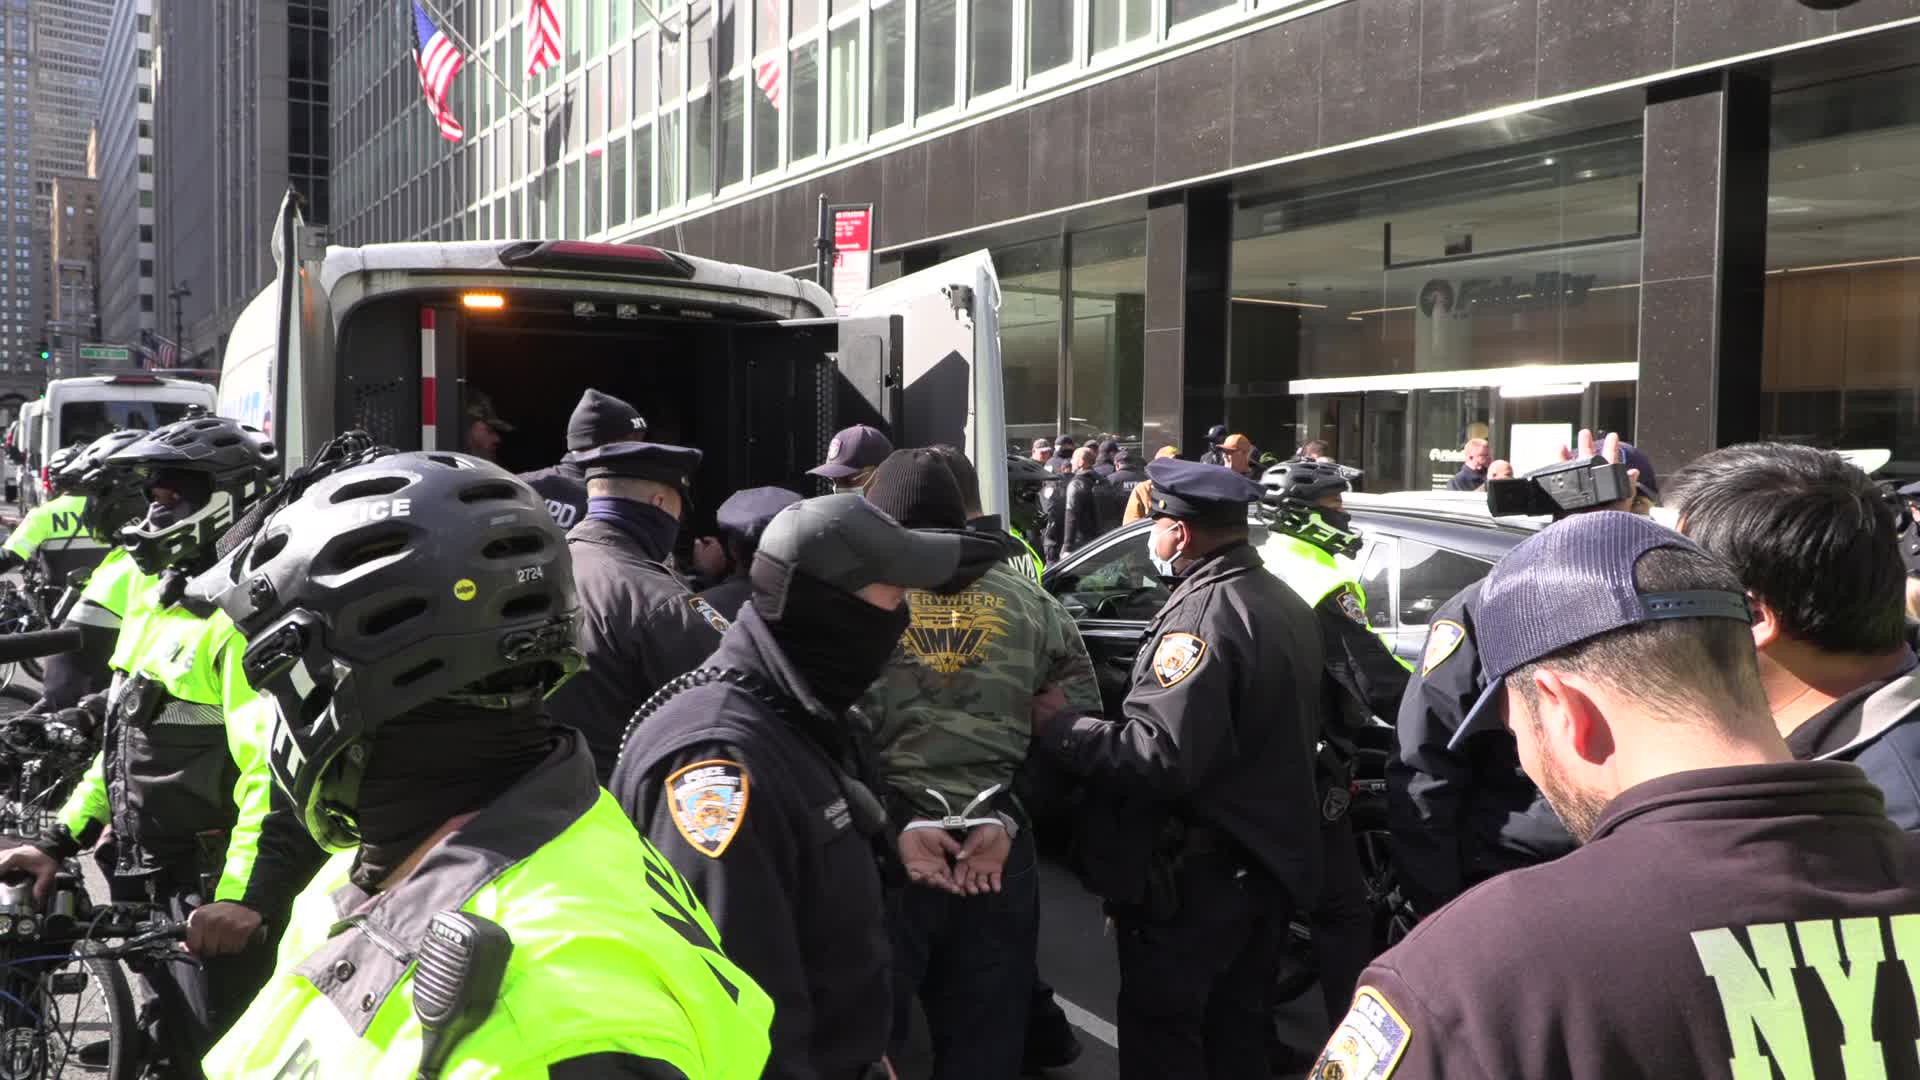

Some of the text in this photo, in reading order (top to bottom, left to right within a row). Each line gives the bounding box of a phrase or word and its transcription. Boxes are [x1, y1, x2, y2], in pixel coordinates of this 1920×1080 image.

[53, 512, 86, 532] NY
[544, 499, 577, 528] PD
[517, 566, 544, 583] 2724
[1690, 913, 1920, 1080] NY
